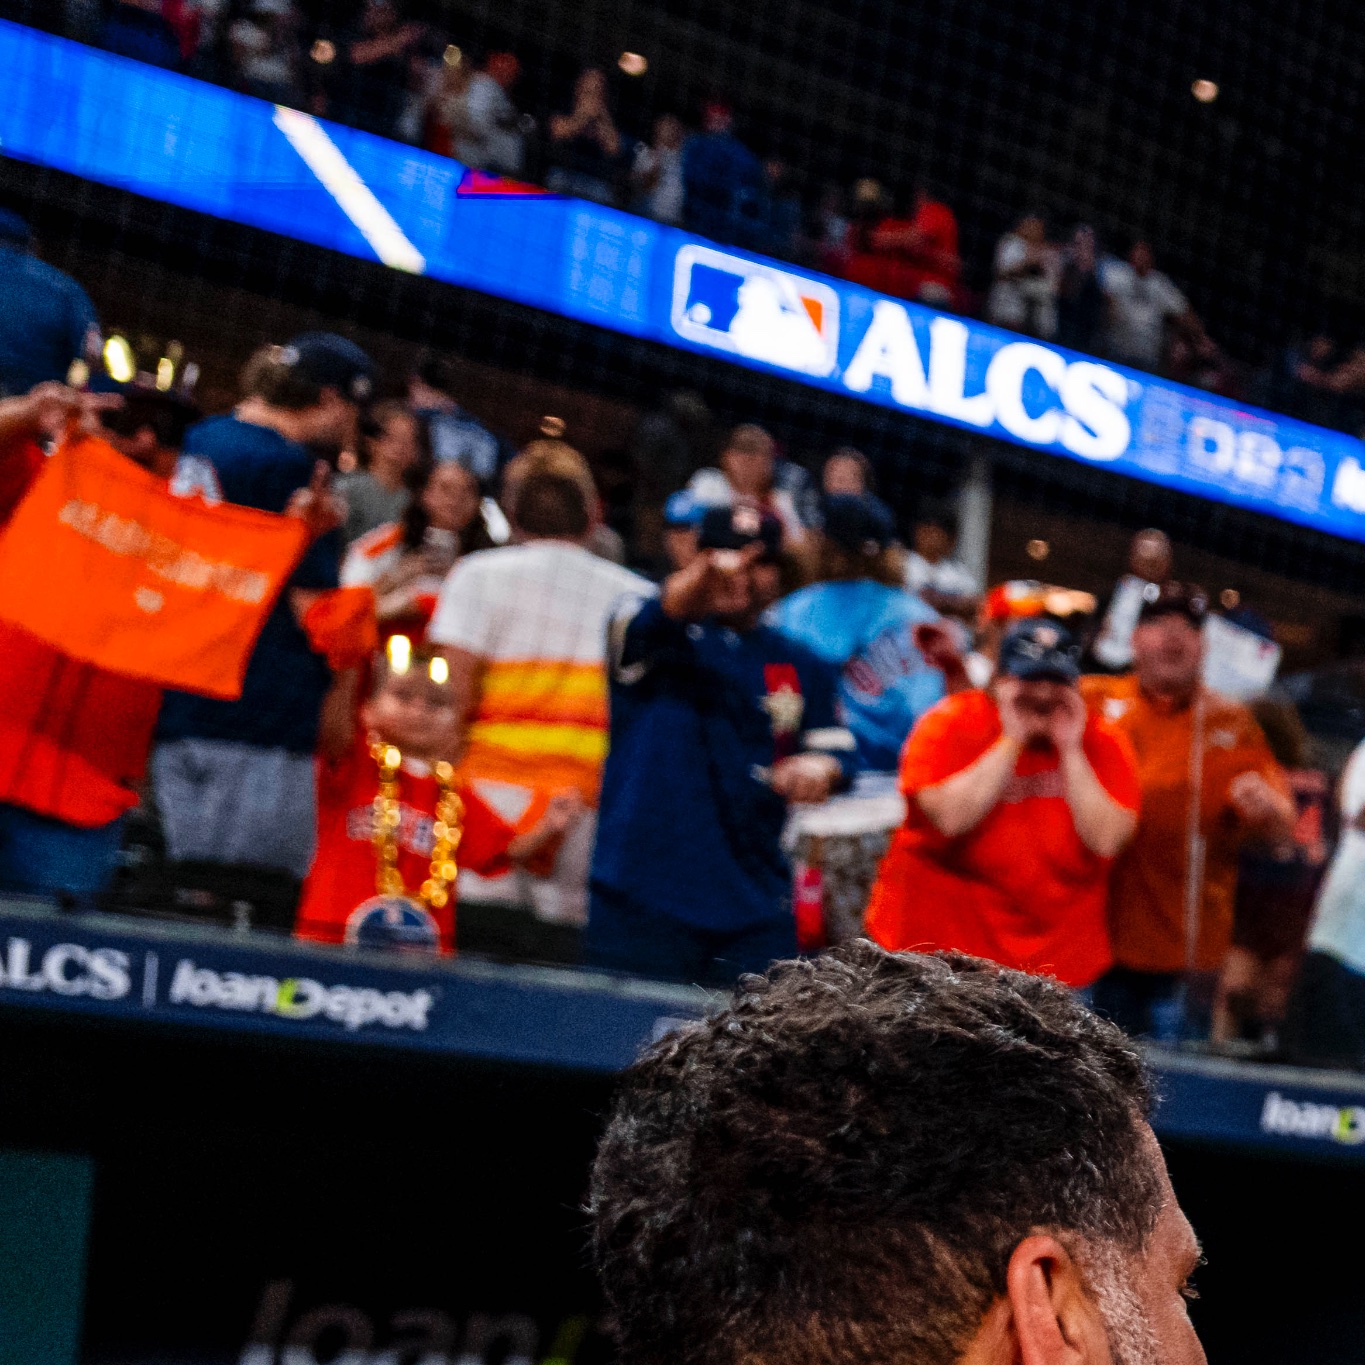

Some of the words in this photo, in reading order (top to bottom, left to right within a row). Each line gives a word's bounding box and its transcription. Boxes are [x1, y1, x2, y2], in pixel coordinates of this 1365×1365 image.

[843, 299, 1131, 461] ALCS
[0, 936, 132, 1000] LCS
[170, 958, 434, 1031] loanDepot
